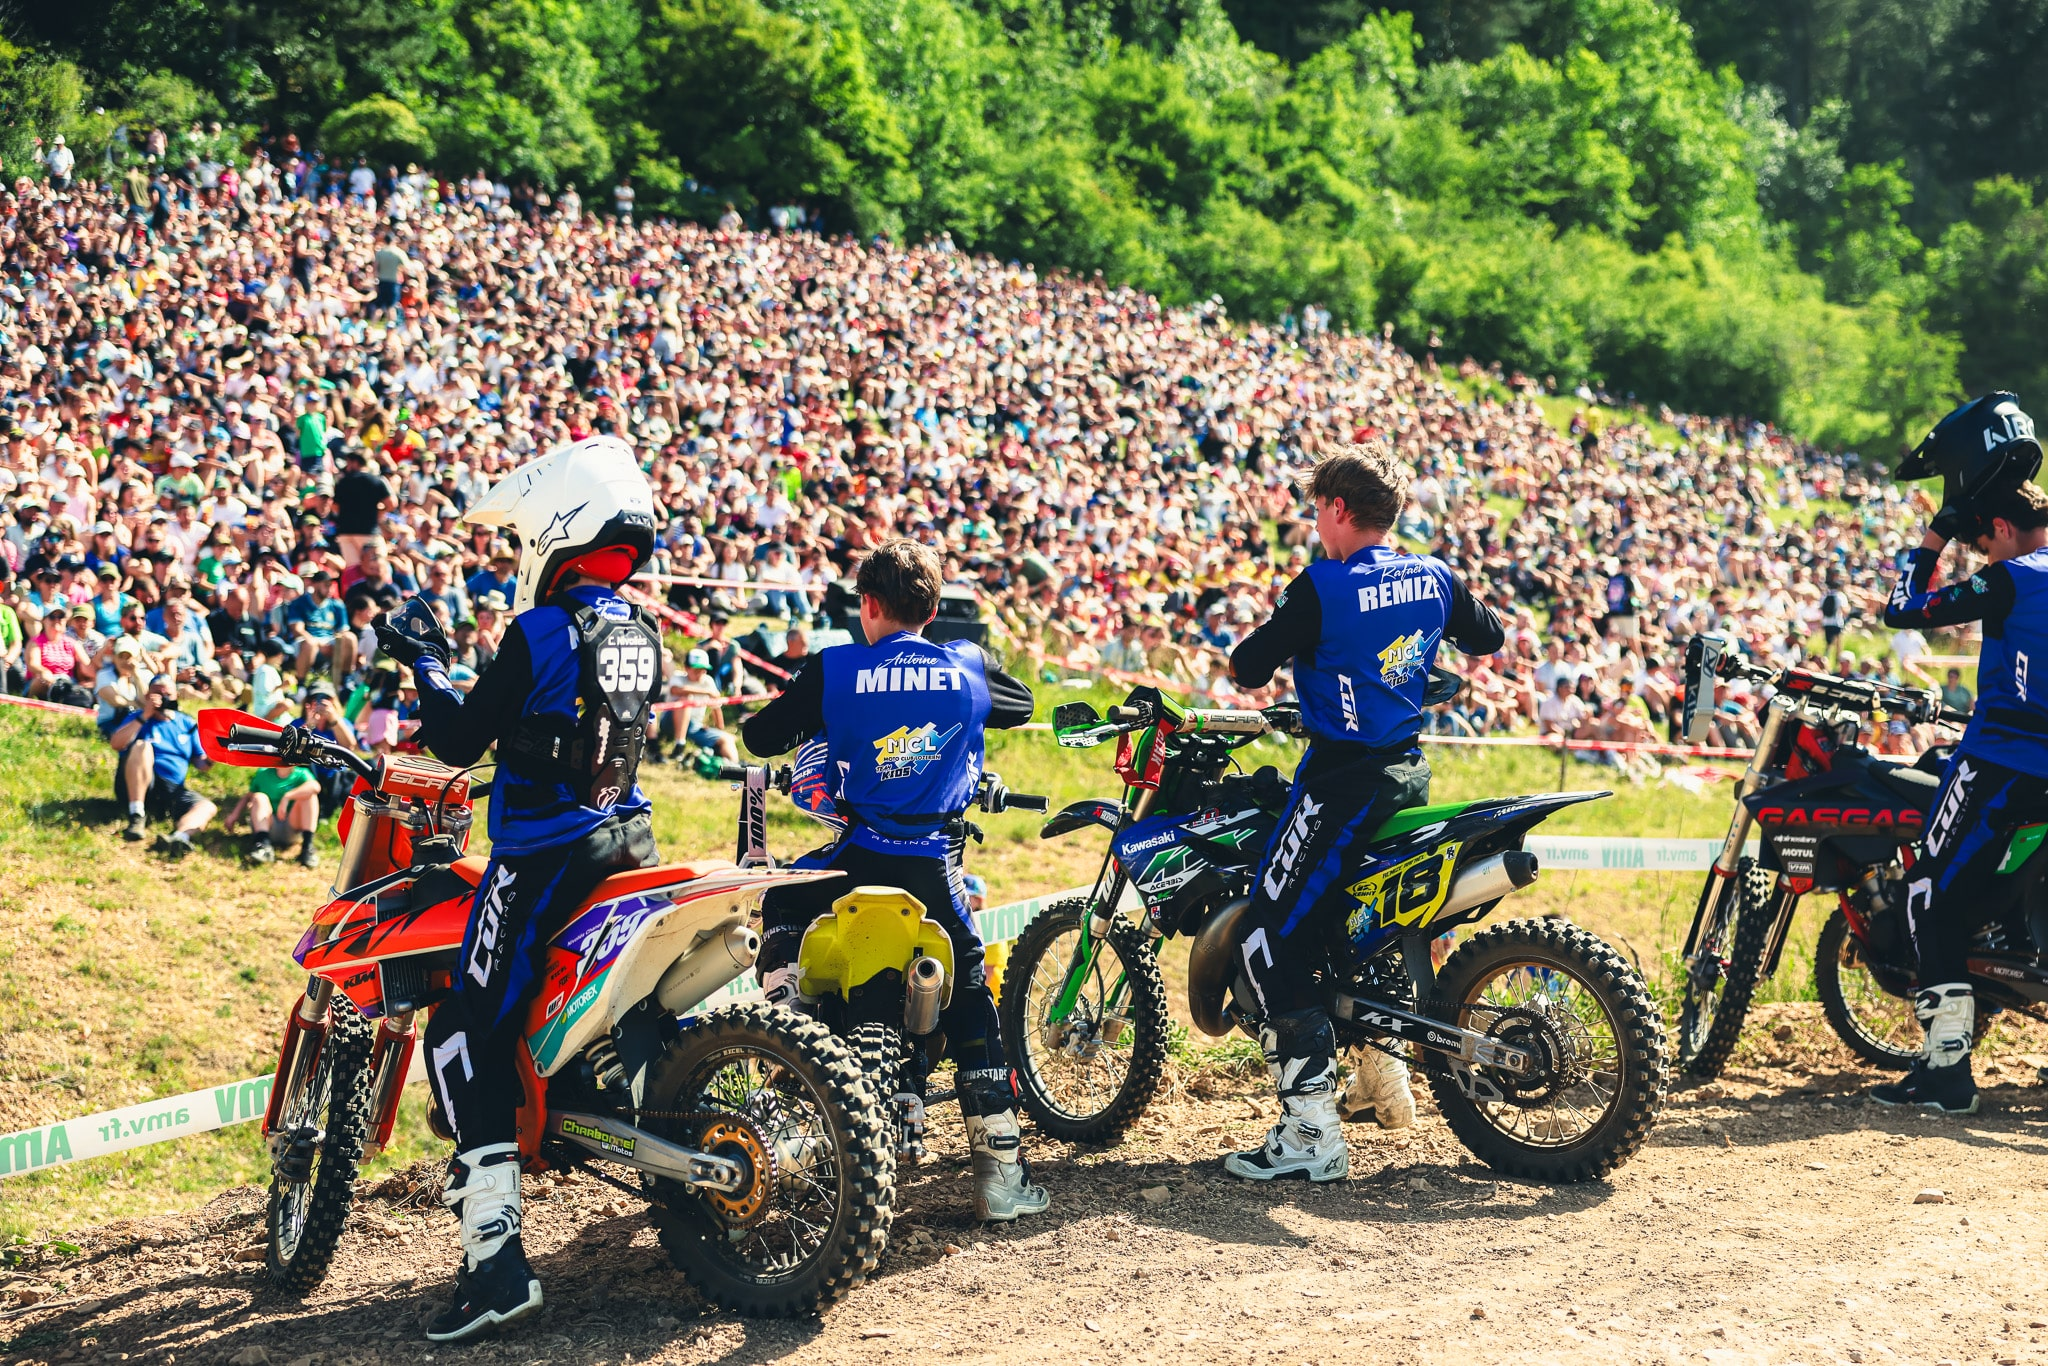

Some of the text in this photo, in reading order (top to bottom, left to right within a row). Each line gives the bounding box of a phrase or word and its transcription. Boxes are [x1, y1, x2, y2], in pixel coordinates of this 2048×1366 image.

[874, 651, 938, 669] Antoine
[1387, 642, 1423, 664] MCL
[598, 647, 655, 692] 359
[855, 667, 962, 693] MINET
[1210, 714, 1259, 724] SCAR
[886, 736, 937, 754] MCL
[389, 771, 465, 794] SCAR
[750, 786, 764, 850] 100%
[1757, 807, 1923, 827] GASGAS
[1121, 830, 1176, 855] Kawasaki
[1781, 848, 1815, 858] MOTUL
[1149, 876, 1184, 892] ACERBIS
[1379, 854, 1444, 923] 18
[343, 970, 376, 990] KTM
[1993, 965, 2025, 978] MOTOREX
[566, 984, 598, 1019] MOTOREX
[1358, 1011, 1416, 1033] KX
[563, 1119, 635, 1150] Charbonnel
